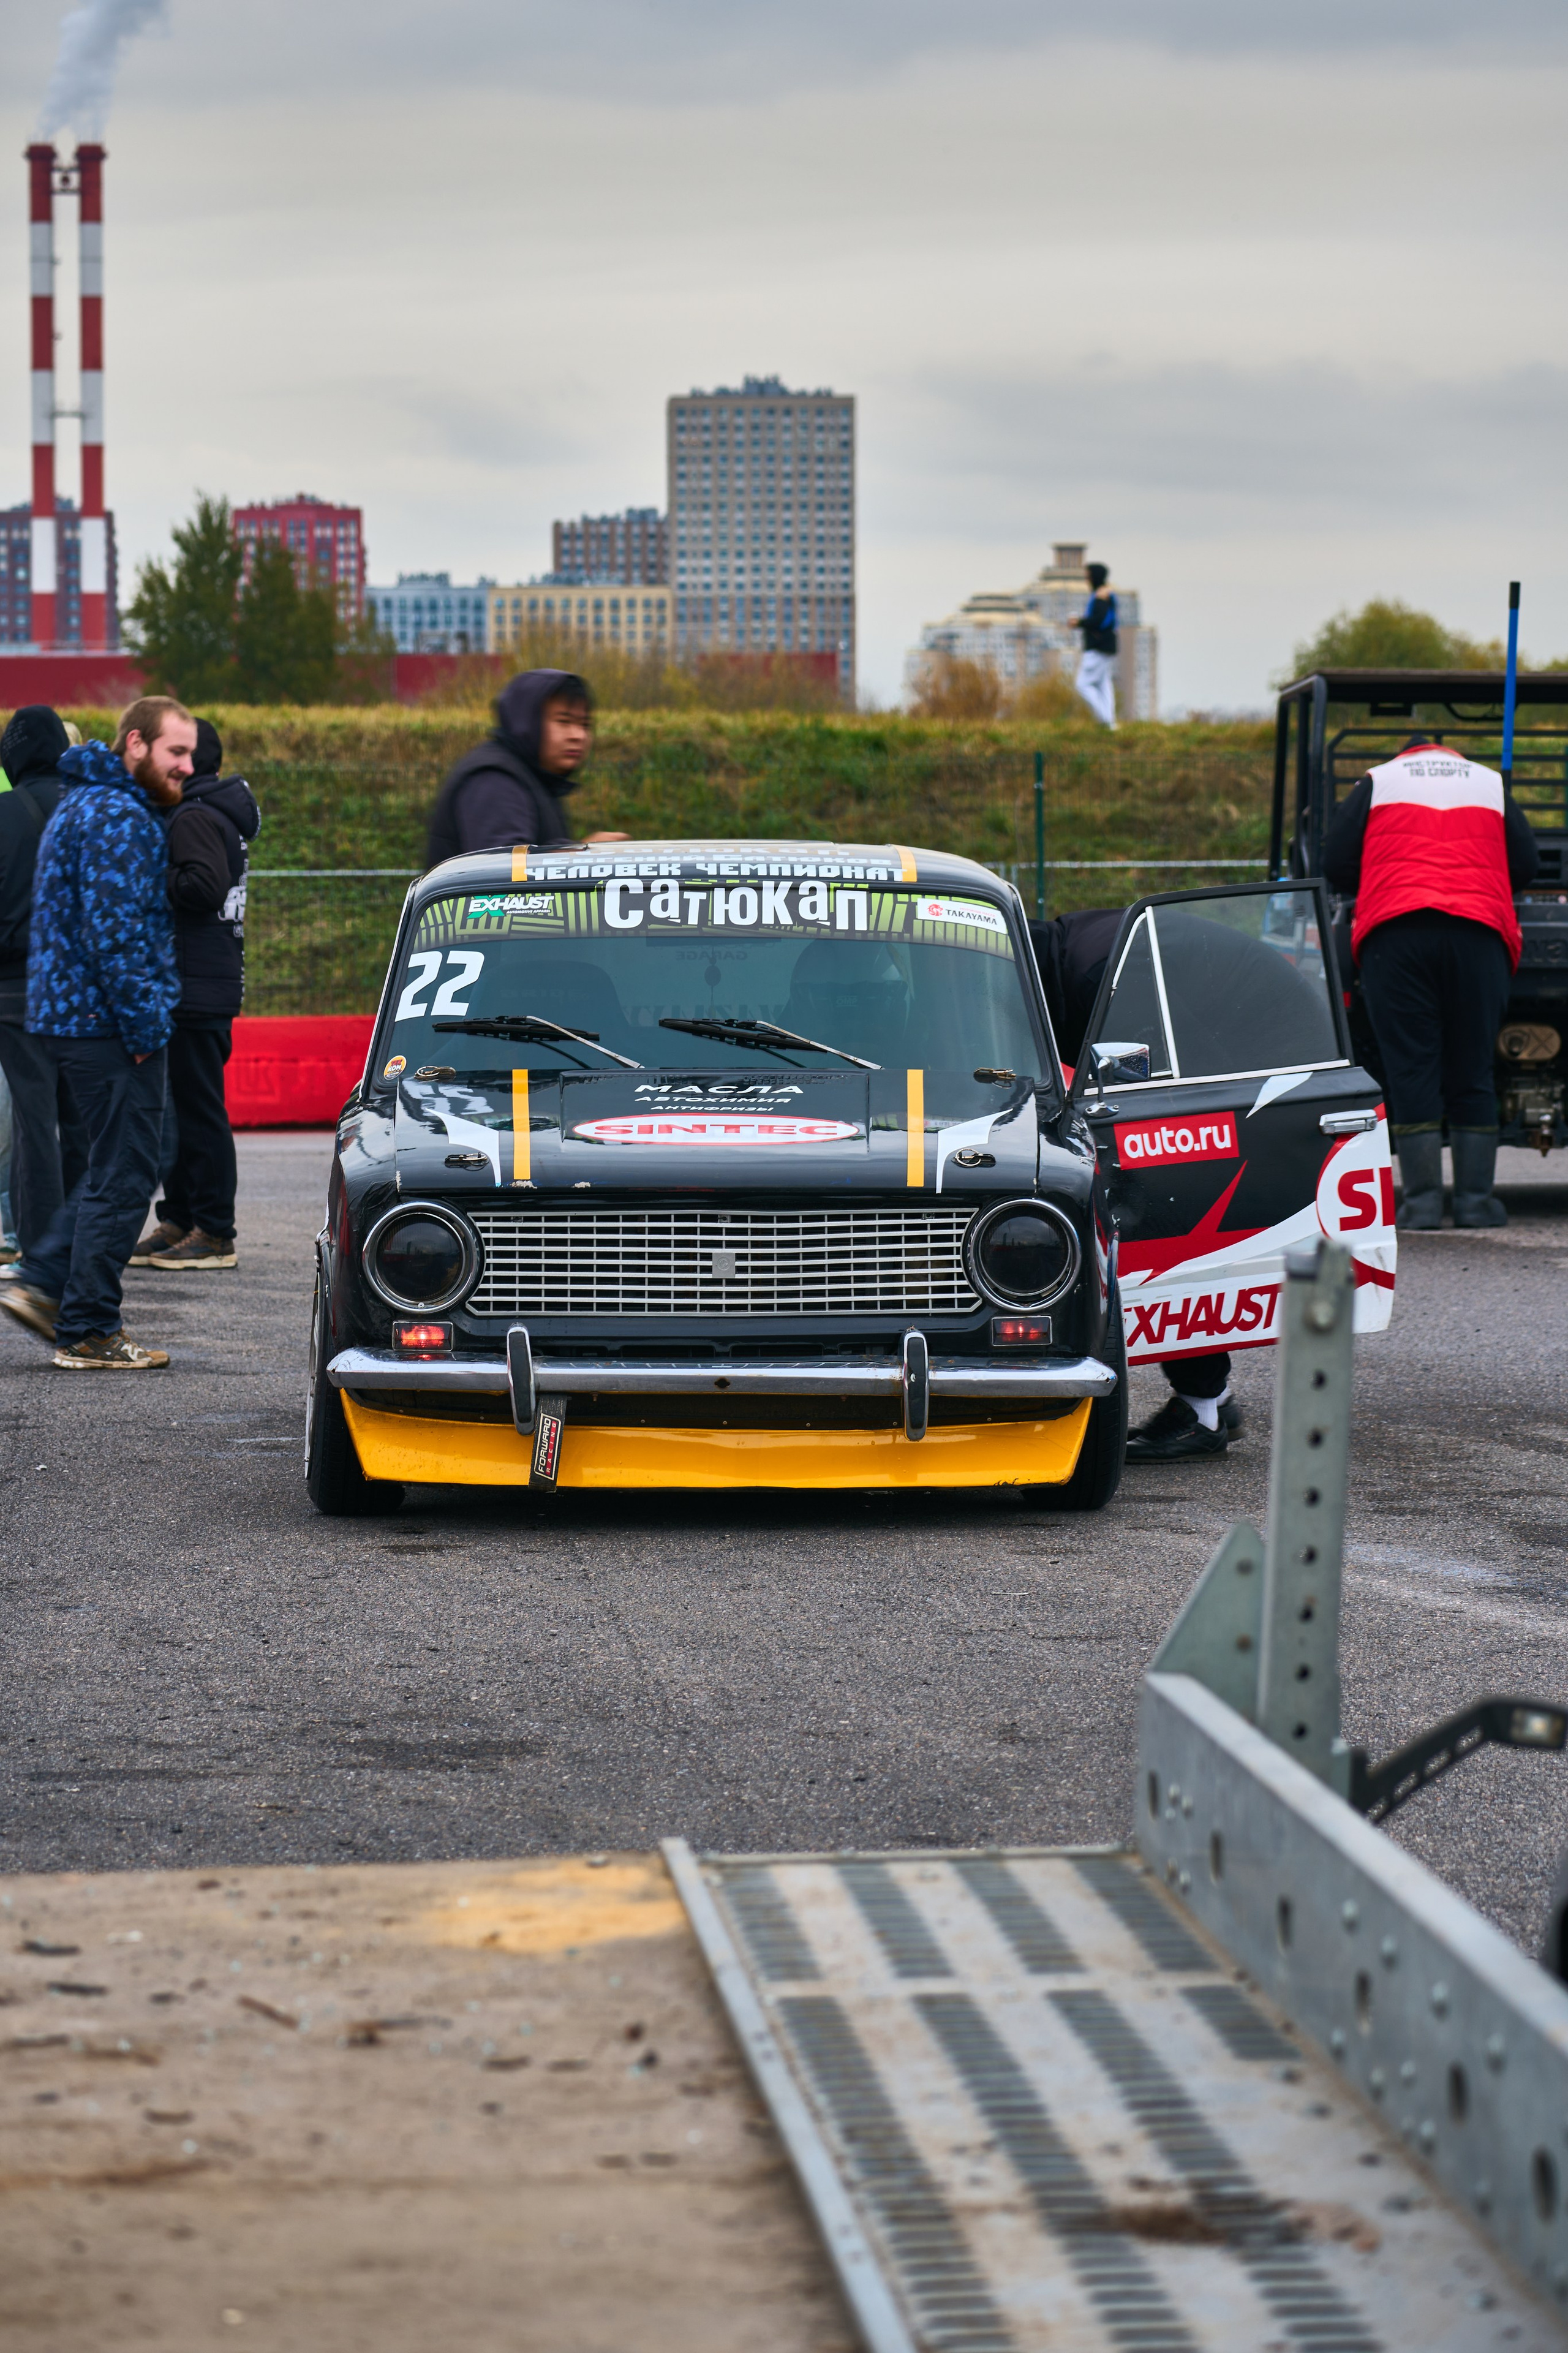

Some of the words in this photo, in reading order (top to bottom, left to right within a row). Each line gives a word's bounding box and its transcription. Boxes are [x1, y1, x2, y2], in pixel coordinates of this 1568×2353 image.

[524, 863, 681, 881] ЧЕЛОВЕК
[696, 863, 908, 882] ЧЕМПИОНАТ
[468, 895, 555, 913] EXHAUST
[945, 908, 998, 926] TAKAYAMA
[394, 950, 485, 1022] 22
[635, 1085, 804, 1093] МАСЛА
[594, 1124, 837, 1135] SINTEC
[1123, 1124, 1232, 1158] auto.ru
[1123, 1282, 1284, 1348] XHAUST
[538, 1417, 551, 1473] FORWARD
[546, 1422, 557, 1473] RACING
